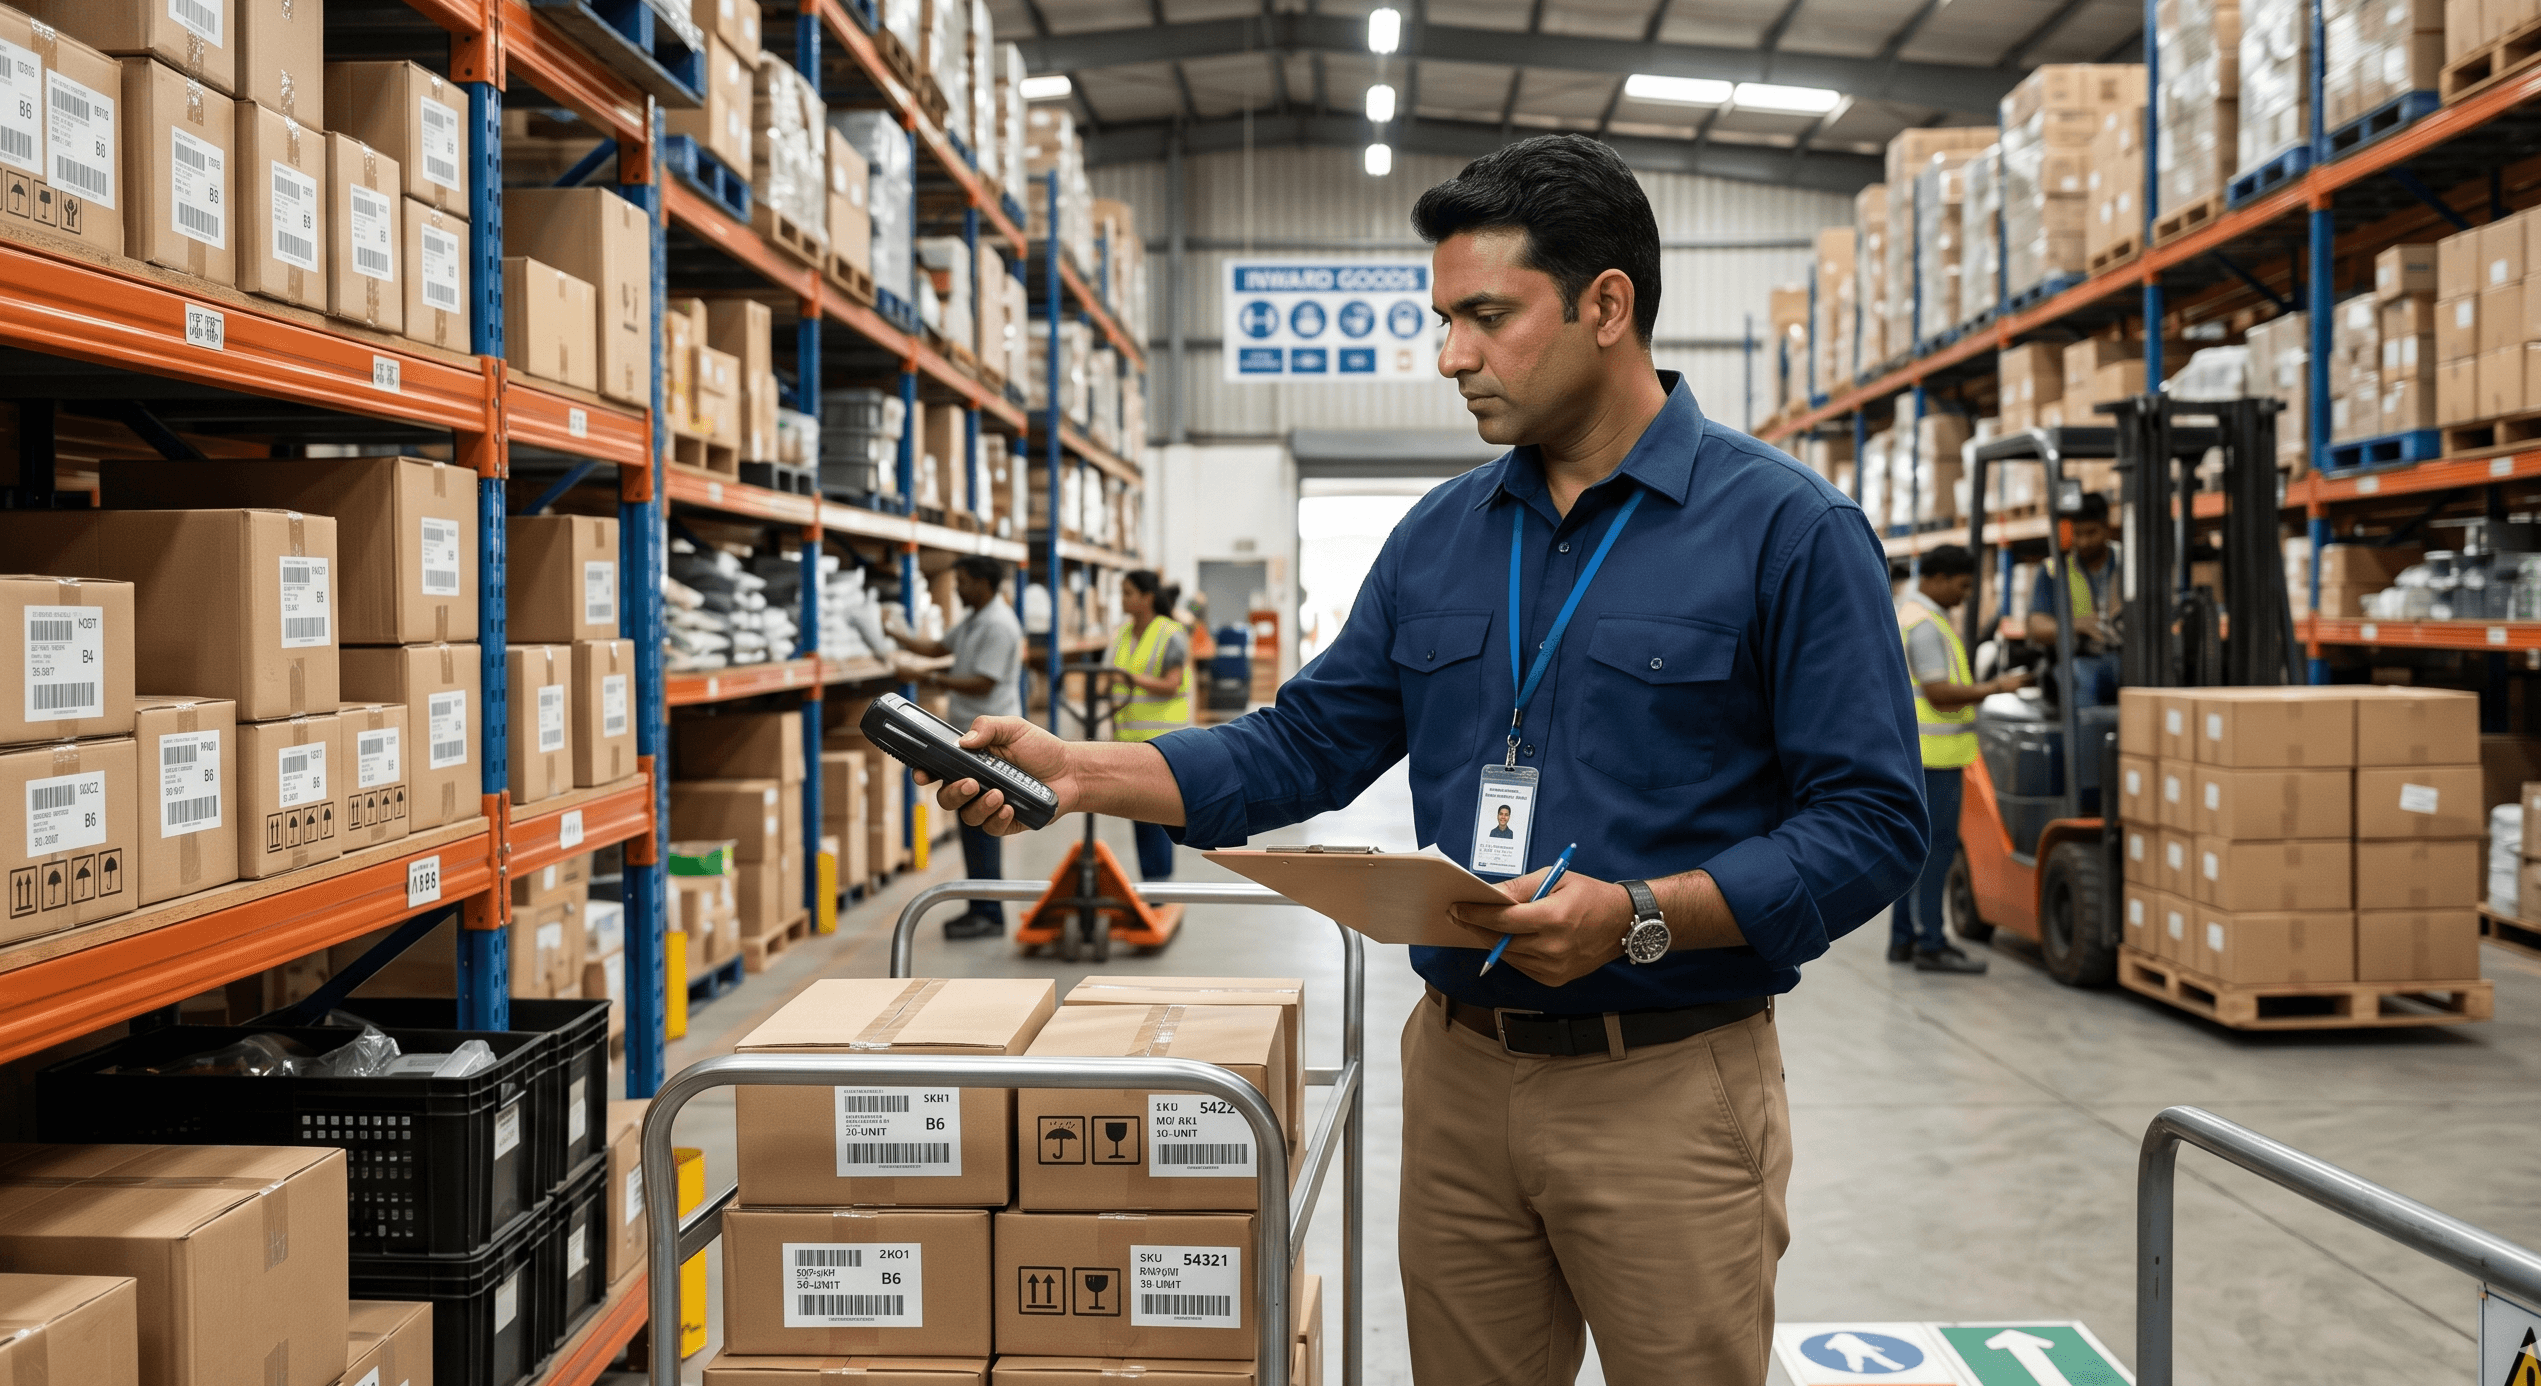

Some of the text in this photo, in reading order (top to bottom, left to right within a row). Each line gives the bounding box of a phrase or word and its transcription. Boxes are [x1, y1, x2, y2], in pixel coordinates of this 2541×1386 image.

[19, 100, 32, 119] B6
[82, 649, 94, 663] B4
[204, 768, 214, 782] B6
[84, 811, 97, 828] B6
[923, 1093, 950, 1103] SKH1
[925, 1117, 945, 1131] B6
[845, 1127, 887, 1136] 20-UNIT
[1140, 1253, 1228, 1267] SKU 54321
[881, 1272, 902, 1285] B6
